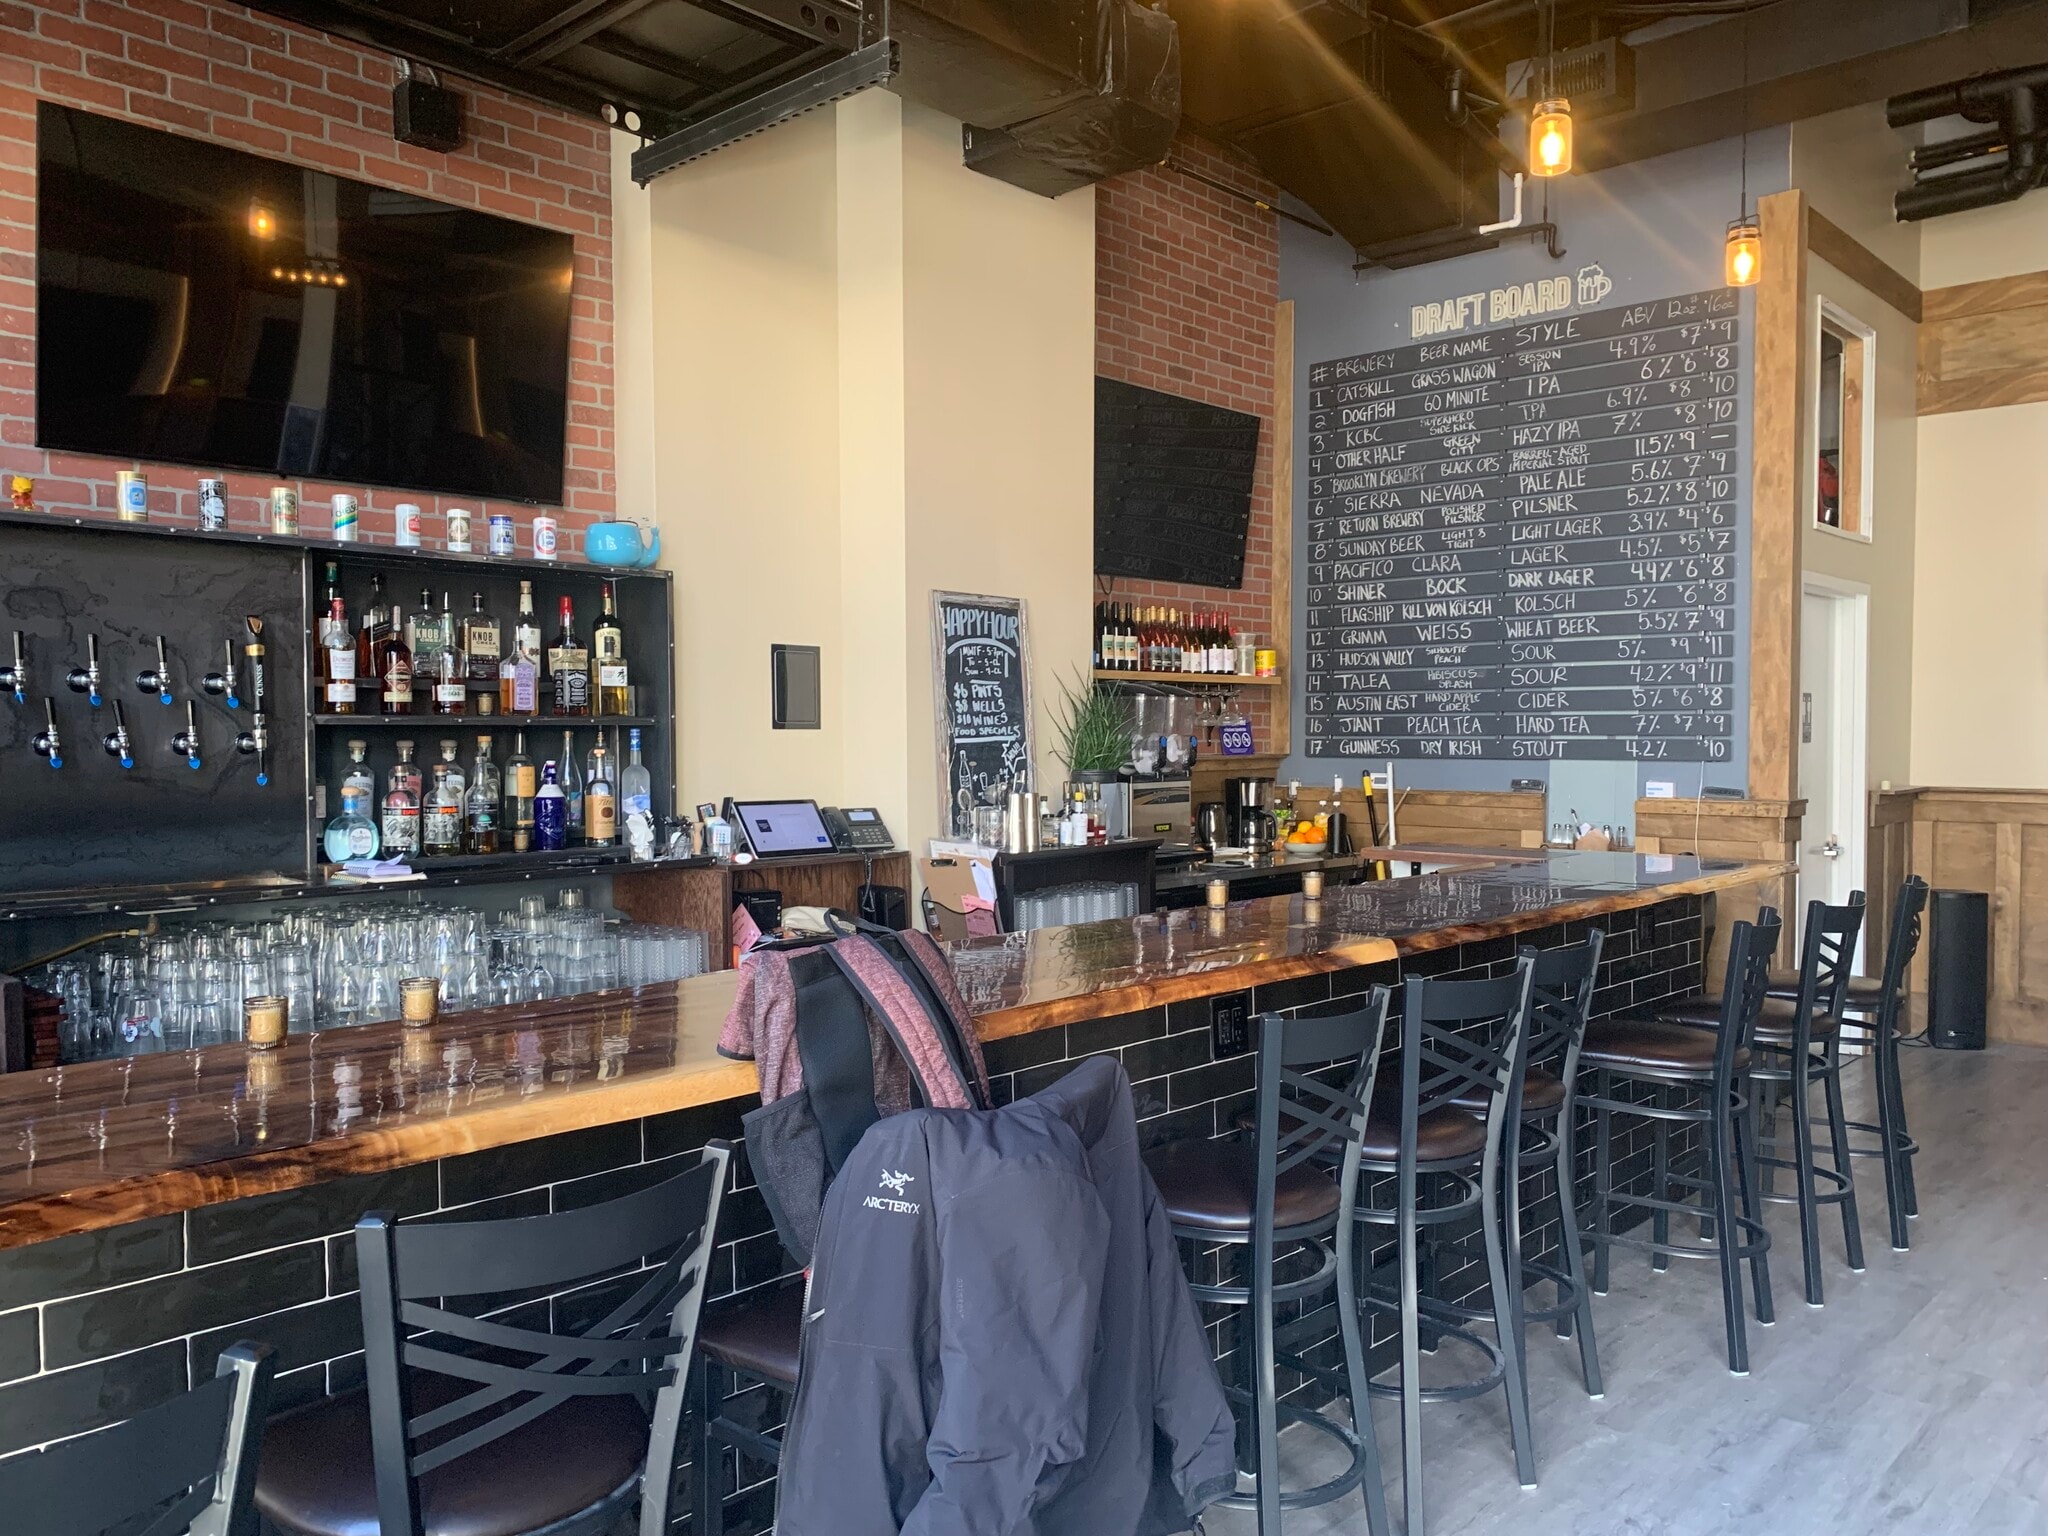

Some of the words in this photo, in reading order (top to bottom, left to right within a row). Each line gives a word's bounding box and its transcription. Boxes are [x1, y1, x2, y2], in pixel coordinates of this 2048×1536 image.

[1411, 292, 1486, 338] DRAFT
[1489, 276, 1572, 323] BOARD
[1336, 353, 1395, 378] BREWERY
[1420, 344, 1450, 363] BEER
[1453, 336, 1493, 357] NAME
[1515, 317, 1581, 347] STYLE
[1621, 303, 1658, 328] ABV
[1315, 392, 1324, 407] 1
[1337, 380, 1394, 403] CATSKILL
[1411, 369, 1450, 389] GRASS
[1453, 362, 1496, 383] WAGON
[1532, 360, 1551, 373] IPA
[1609, 334, 1657, 359] 4.9%
[1518, 350, 1562, 367] SESSION
[1315, 415, 1326, 429] 2
[1343, 400, 1395, 425] DOGFISH
[1424, 394, 1441, 412] 60
[1445, 385, 1490, 408] MINUTE
[1528, 374, 1561, 397] IPA
[1314, 435, 1325, 453] 3
[1347, 426, 1383, 448] KCBC
[1607, 387, 1647, 408] 6.9%
[1312, 459, 1321, 473] 4
[1336, 450, 1371, 469] OTHER
[1374, 445, 1407, 464] HALF
[1449, 444, 1475, 457] CITY
[1513, 423, 1554, 446] HAZY
[1557, 420, 1581, 441] IPA
[1443, 433, 1481, 448] GREEN
[1314, 479, 1322, 495] 5
[1333, 472, 1377, 493] BROOKLYN
[1380, 465, 1426, 486] BREWERY
[1441, 461, 1473, 476] BLACK
[1476, 457, 1500, 472] OPS
[1509, 458, 1555, 473] IMPERIAL
[1557, 453, 1590, 466] STOUT
[1314, 501, 1324, 515] 6
[1344, 491, 1401, 513] SIERRA
[1420, 483, 1484, 504] NEVADA
[1519, 473, 1553, 494] PALE
[1557, 467, 1586, 490] ALE
[1631, 459, 1673, 482] 5.6%
[1314, 523, 1325, 539] 7
[1339, 516, 1378, 535] RETURN
[1383, 509, 1426, 528] BREWERY
[1512, 494, 1578, 518] PILSNER
[1441, 503, 1486, 517] POLISHED
[1314, 543, 1326, 559] 8
[1339, 539, 1387, 557] SUNDAY
[1390, 535, 1425, 554] BEER
[1446, 538, 1474, 549] TIGHT
[1512, 523, 1552, 542] LIGHT
[1555, 517, 1603, 537] LAGER
[1441, 529, 1474, 540] LIGHT
[1315, 566, 1323, 581] 9
[1334, 559, 1393, 580] PACIFICO
[1412, 554, 1461, 572] CLARA
[1511, 545, 1568, 565] LAGER
[1619, 537, 1663, 559] 4.5%
[1310, 589, 1322, 603] 10
[1337, 583, 1386, 601] SHINER
[1426, 577, 1467, 596] BOCK
[1508, 571, 1544, 588] DARK
[1548, 567, 1595, 586] LAGER
[1341, 605, 1394, 623] FLAGSHIP
[1402, 603, 1424, 619] KILL
[1425, 602, 1447, 617] VON
[1515, 592, 1576, 614] KOLSCH
[1624, 588, 1657, 608] 5%
[416, 628, 439, 639] KNOB
[472, 631, 493, 642] KNOB
[944, 606, 984, 637] HAPPY
[984, 610, 1020, 647] HOUR
[1312, 632, 1325, 646] 12
[1341, 629, 1387, 645] GRIMM
[1416, 622, 1472, 641] WEISS
[1505, 619, 1553, 638] WHEAT
[1558, 616, 1600, 636] BEER
[1638, 610, 1679, 631] 5.5%
[1312, 653, 1324, 668] 13
[1340, 652, 1380, 666] HUDSON
[1434, 655, 1461, 664] PEACH
[1511, 644, 1556, 662] SOUR
[1617, 640, 1646, 658] 5%
[1308, 676, 1320, 691] 14
[1334, 673, 1391, 690] TALEA
[1438, 679, 1472, 689] SPLASH
[1511, 667, 1568, 686] SOUR
[1630, 663, 1676, 683] 4.2%
[1427, 669, 1478, 681] HIBISCUS
[953, 682, 968, 699] $6
[1310, 698, 1323, 712] 15
[1336, 695, 1382, 712] AUSTIN
[1386, 694, 1418, 711] EAST
[1438, 702, 1471, 712] CIDER
[1518, 692, 1570, 709] CIDER
[1631, 687, 1663, 708] 5%
[1425, 693, 1451, 703] HARD
[1453, 692, 1481, 704] APPLE
[955, 699, 968, 713] $8
[972, 699, 1005, 713] WELLS
[972, 712, 1008, 726] WINES
[979, 725, 1020, 738] SPECIALS
[1310, 718, 1322, 733] 16
[1339, 717, 1384, 733] JIANT
[1407, 716, 1450, 735] PEACH
[1453, 715, 1483, 735] TEA
[1516, 715, 1555, 734] HARD
[1558, 716, 1591, 734] TEA
[1631, 714, 1660, 734] 7%
[1310, 740, 1323, 755] 17
[1339, 739, 1400, 755] GUINNESS
[1421, 740, 1442, 755] DRY
[1449, 740, 1482, 755] IRISH
[1512, 740, 1568, 758] STOUT
[1626, 740, 1668, 758] 4.2%
